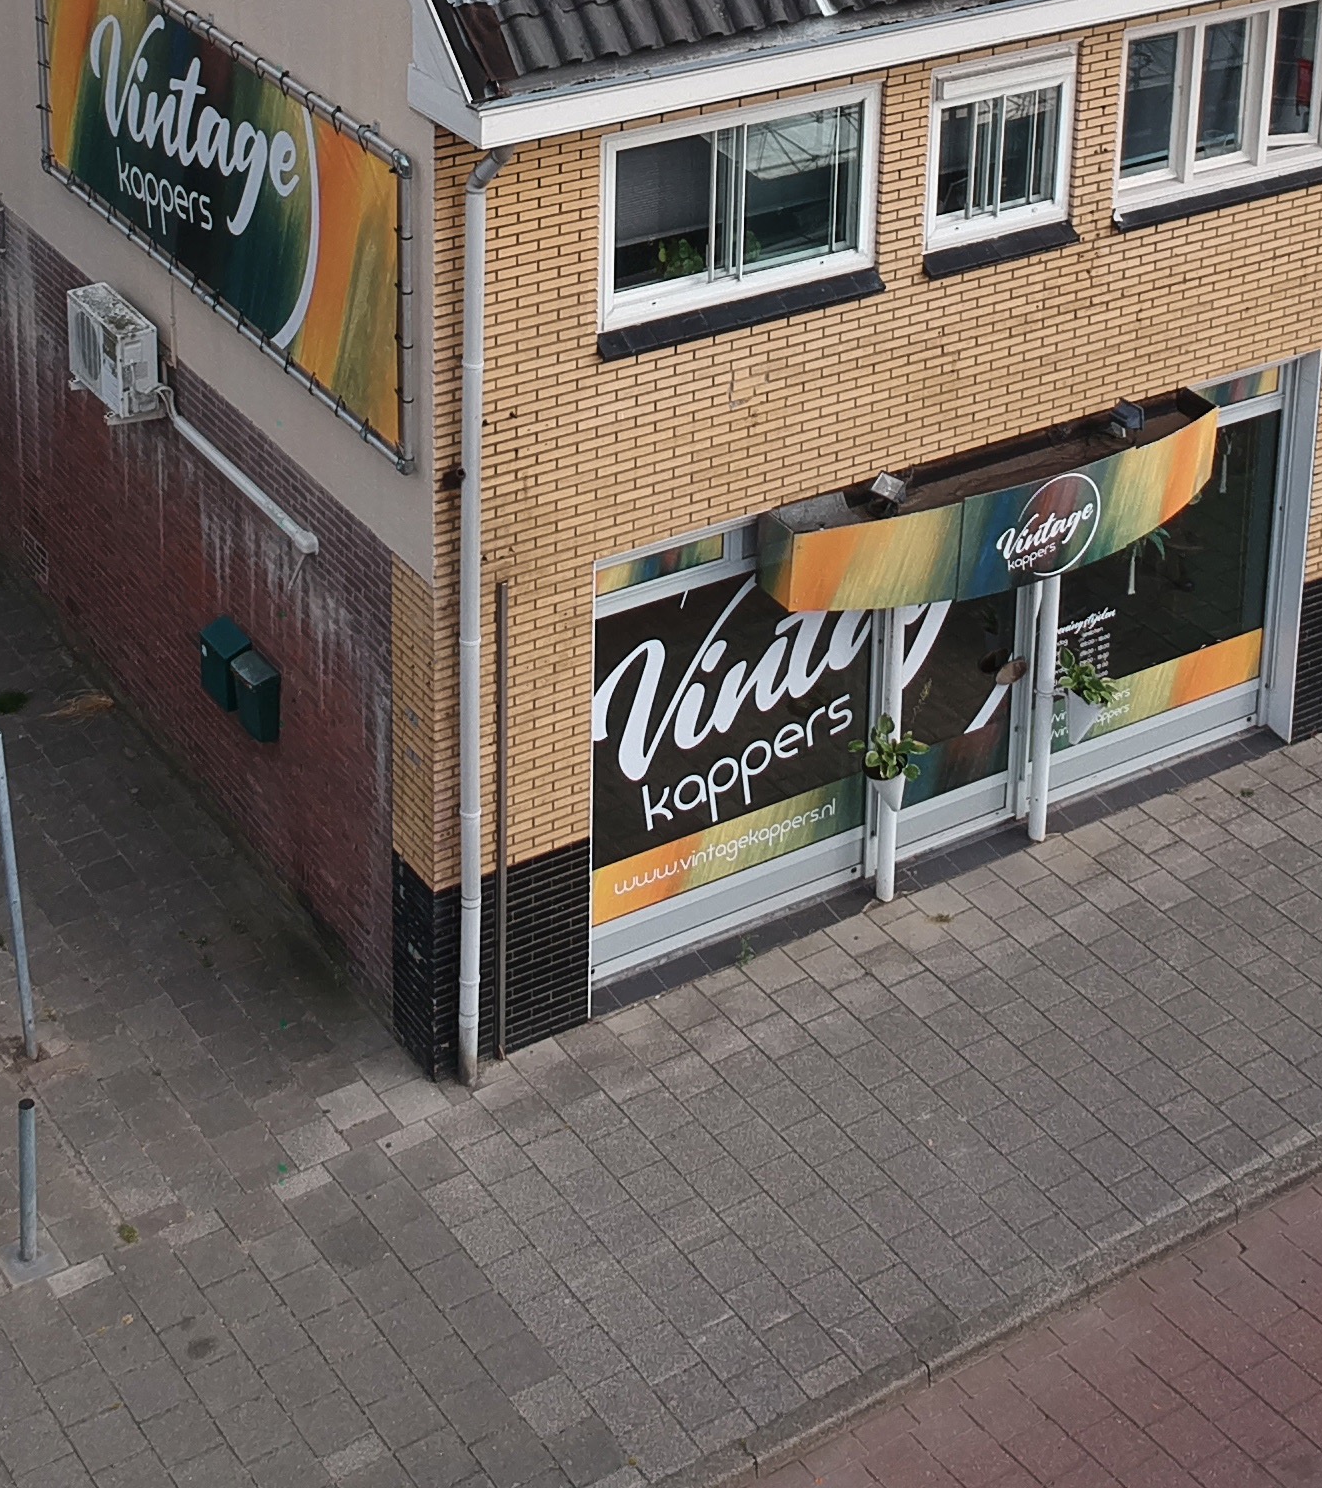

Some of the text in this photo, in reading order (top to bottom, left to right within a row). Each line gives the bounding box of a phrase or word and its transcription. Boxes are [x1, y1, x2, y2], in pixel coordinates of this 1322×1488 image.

[90, 14, 300, 236] Vintage
[116, 147, 213, 235] kappers
[996, 503, 1093, 559] Vintage
[1007, 542, 1056, 571] kappers
[642, 694, 853, 831] kappers
[614, 798, 836, 896] www.vintagekappers.nl
